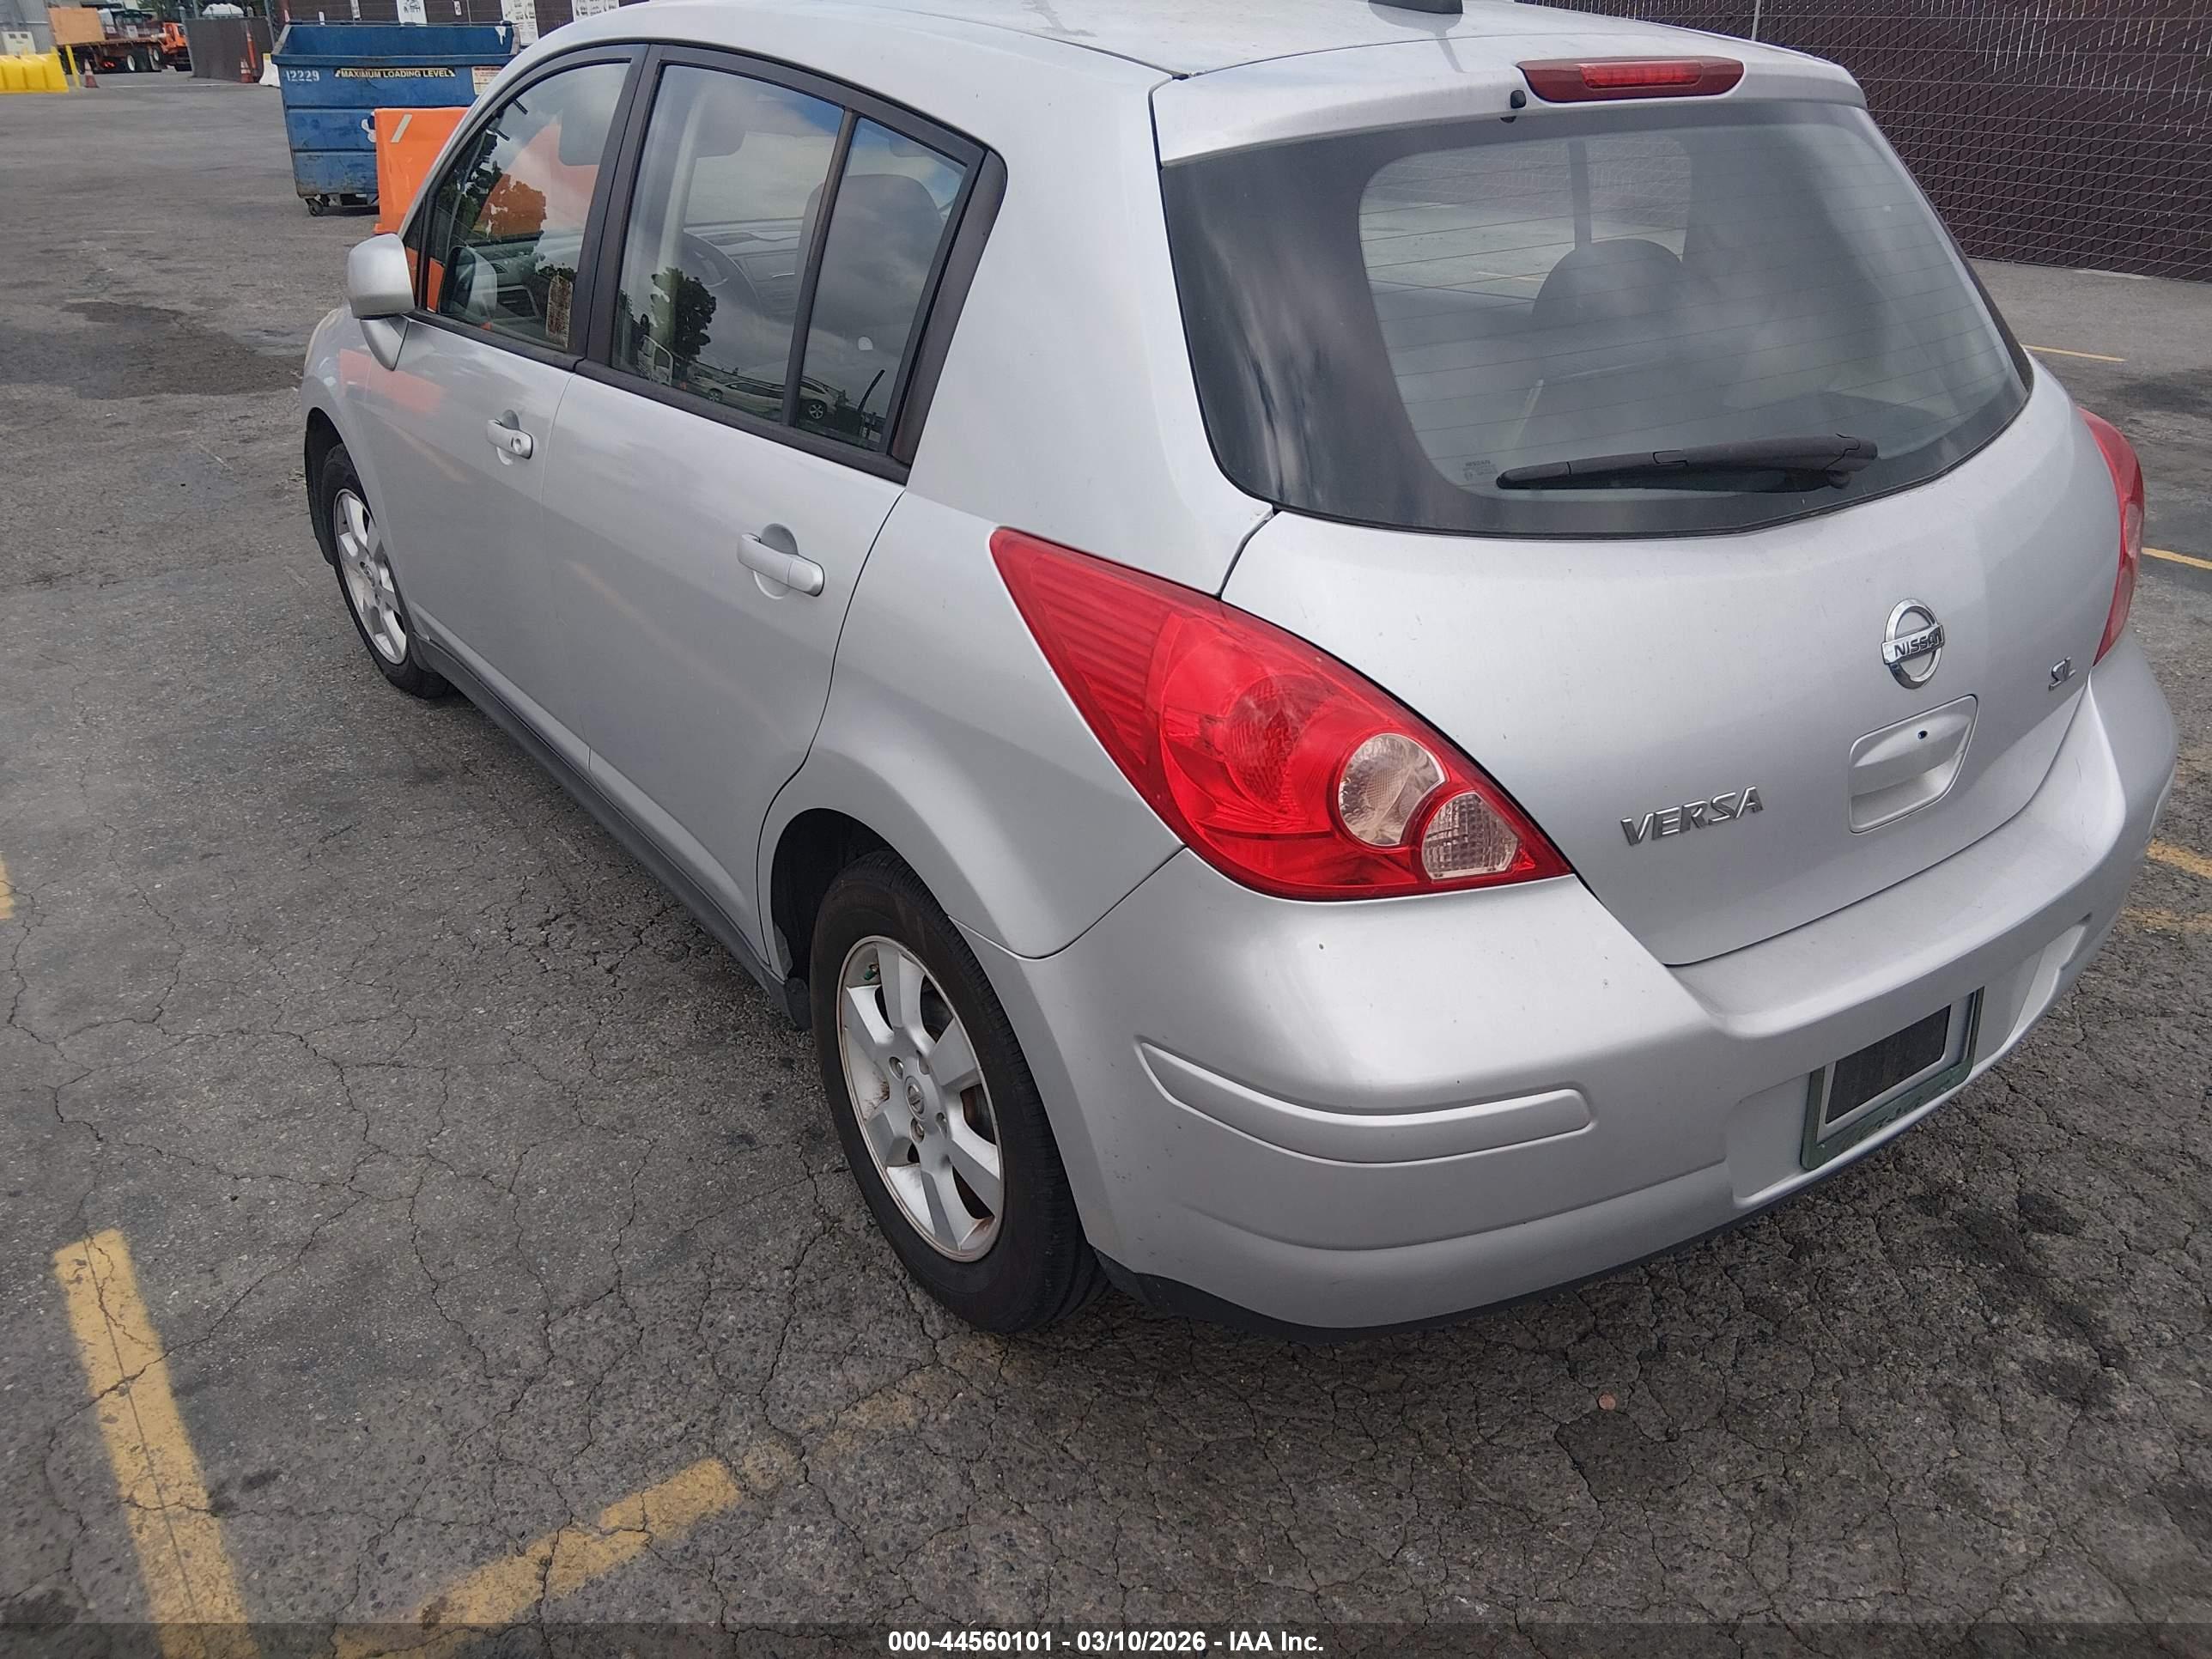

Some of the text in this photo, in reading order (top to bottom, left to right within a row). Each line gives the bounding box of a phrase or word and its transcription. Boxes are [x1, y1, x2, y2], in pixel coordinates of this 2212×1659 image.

[286, 70, 320, 82] 12229
[341, 69, 447, 78] MAXIMUM LOADING LEVEL
[1894, 627, 1942, 658] NISSAN
[2049, 657, 2075, 690] SL
[1620, 785, 1764, 846] VERSA
